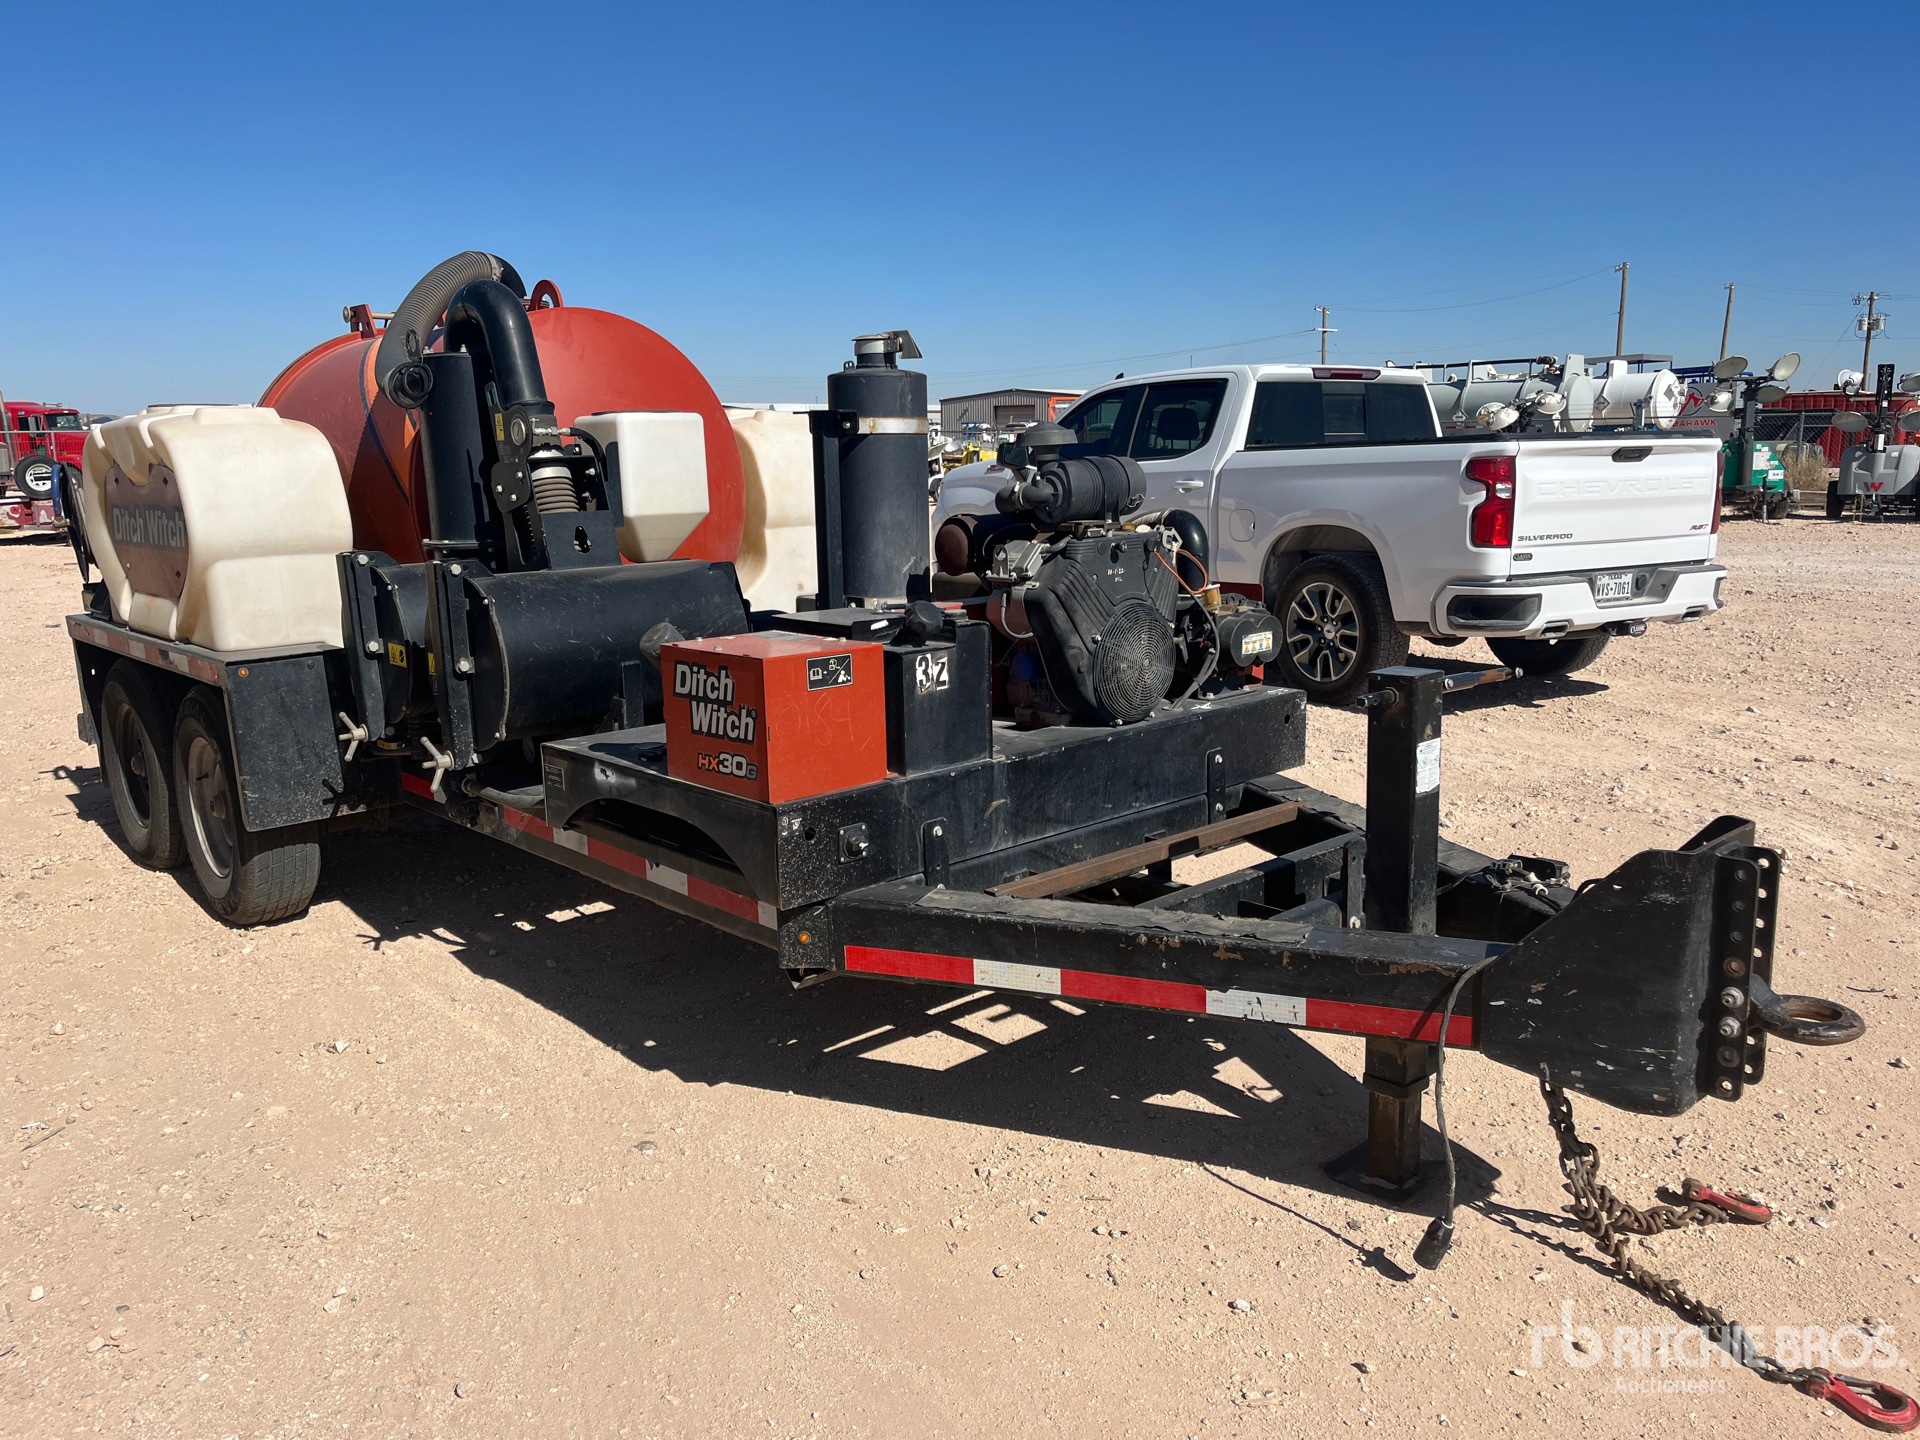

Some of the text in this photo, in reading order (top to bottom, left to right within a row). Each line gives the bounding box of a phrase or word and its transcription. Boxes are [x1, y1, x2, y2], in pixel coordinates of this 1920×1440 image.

[1673, 419, 1717, 428] MAHAWK
[1536, 476, 1710, 498] CHEVROLET
[112, 507, 185, 548] Ditch Witch
[1517, 532, 1573, 542] SILVERADO
[675, 663, 733, 702] Ditch
[917, 654, 948, 689] 32
[691, 700, 755, 741] Witch
[698, 753, 758, 780] HX30G
